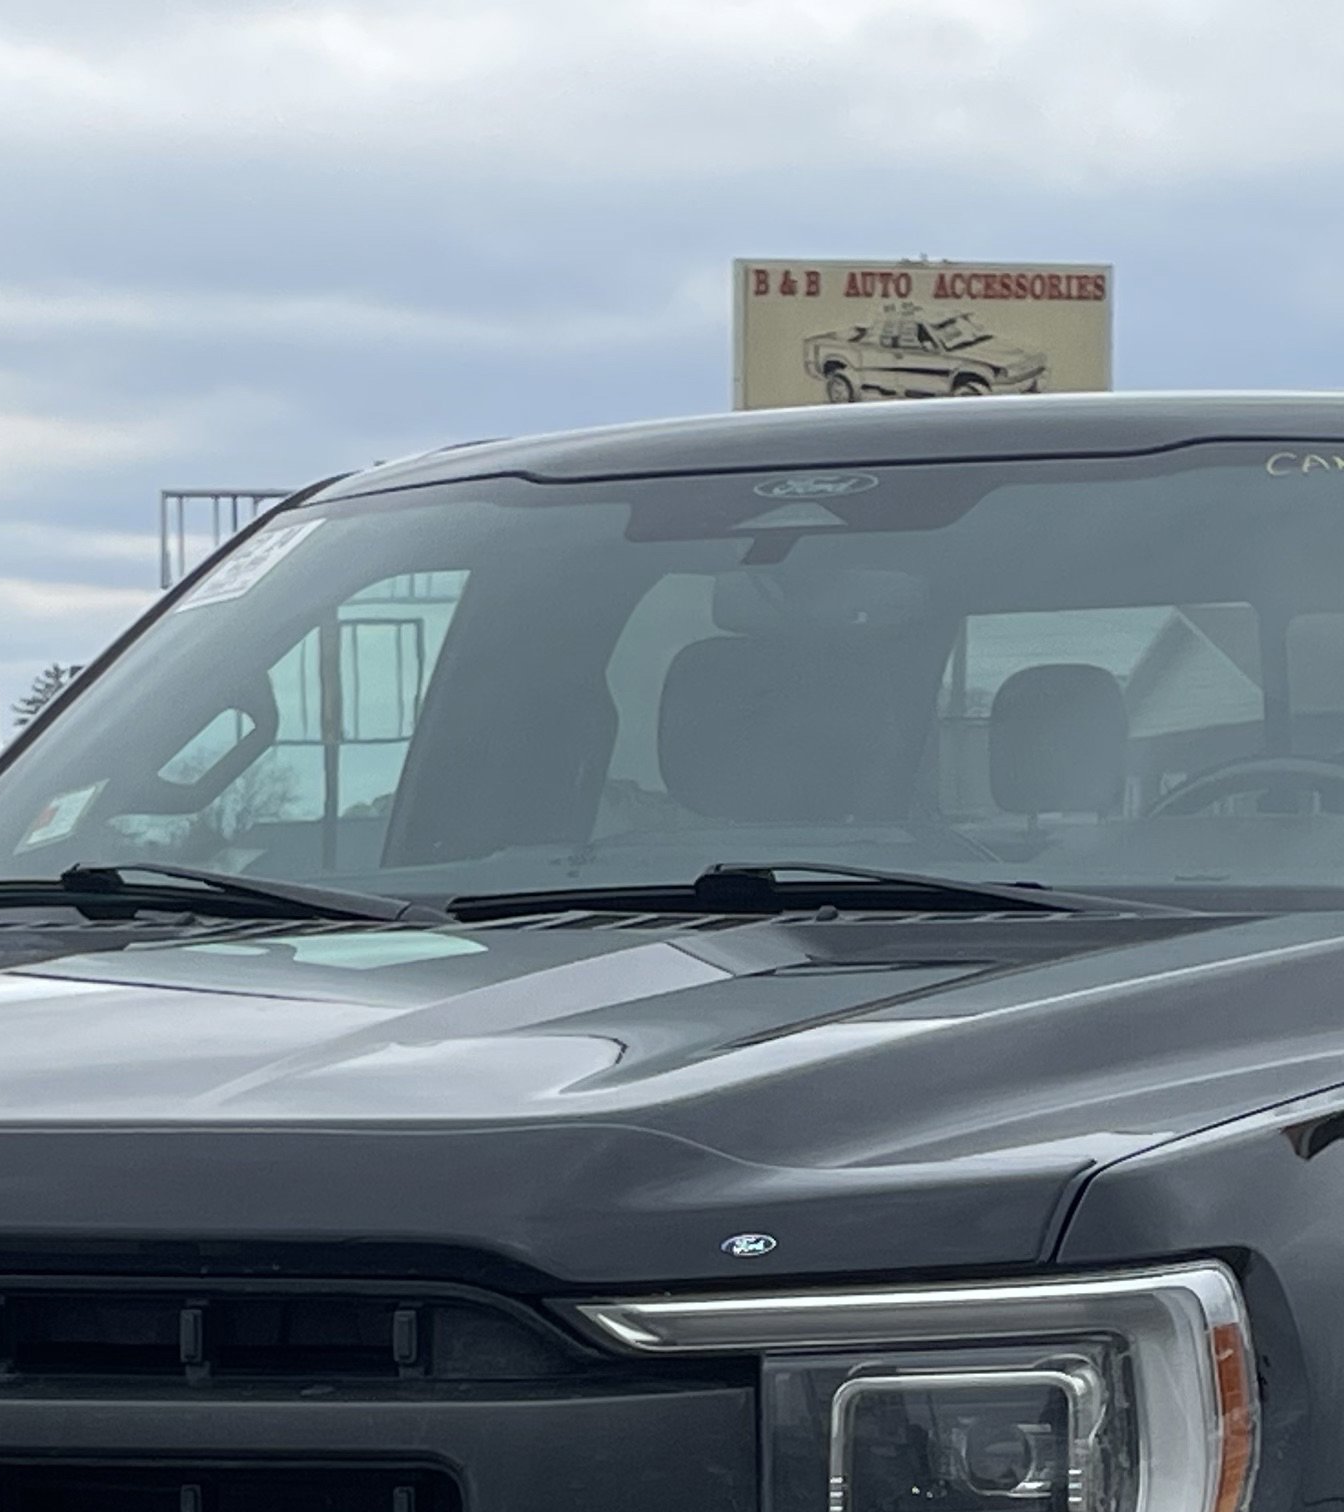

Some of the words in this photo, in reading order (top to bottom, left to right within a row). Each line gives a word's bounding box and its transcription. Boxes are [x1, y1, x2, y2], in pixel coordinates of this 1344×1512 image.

[753, 269, 770, 296] B
[780, 269, 798, 296] &
[805, 270, 821, 297] B
[844, 271, 913, 299] AUTO
[933, 272, 1105, 301] ACCESSORIES
